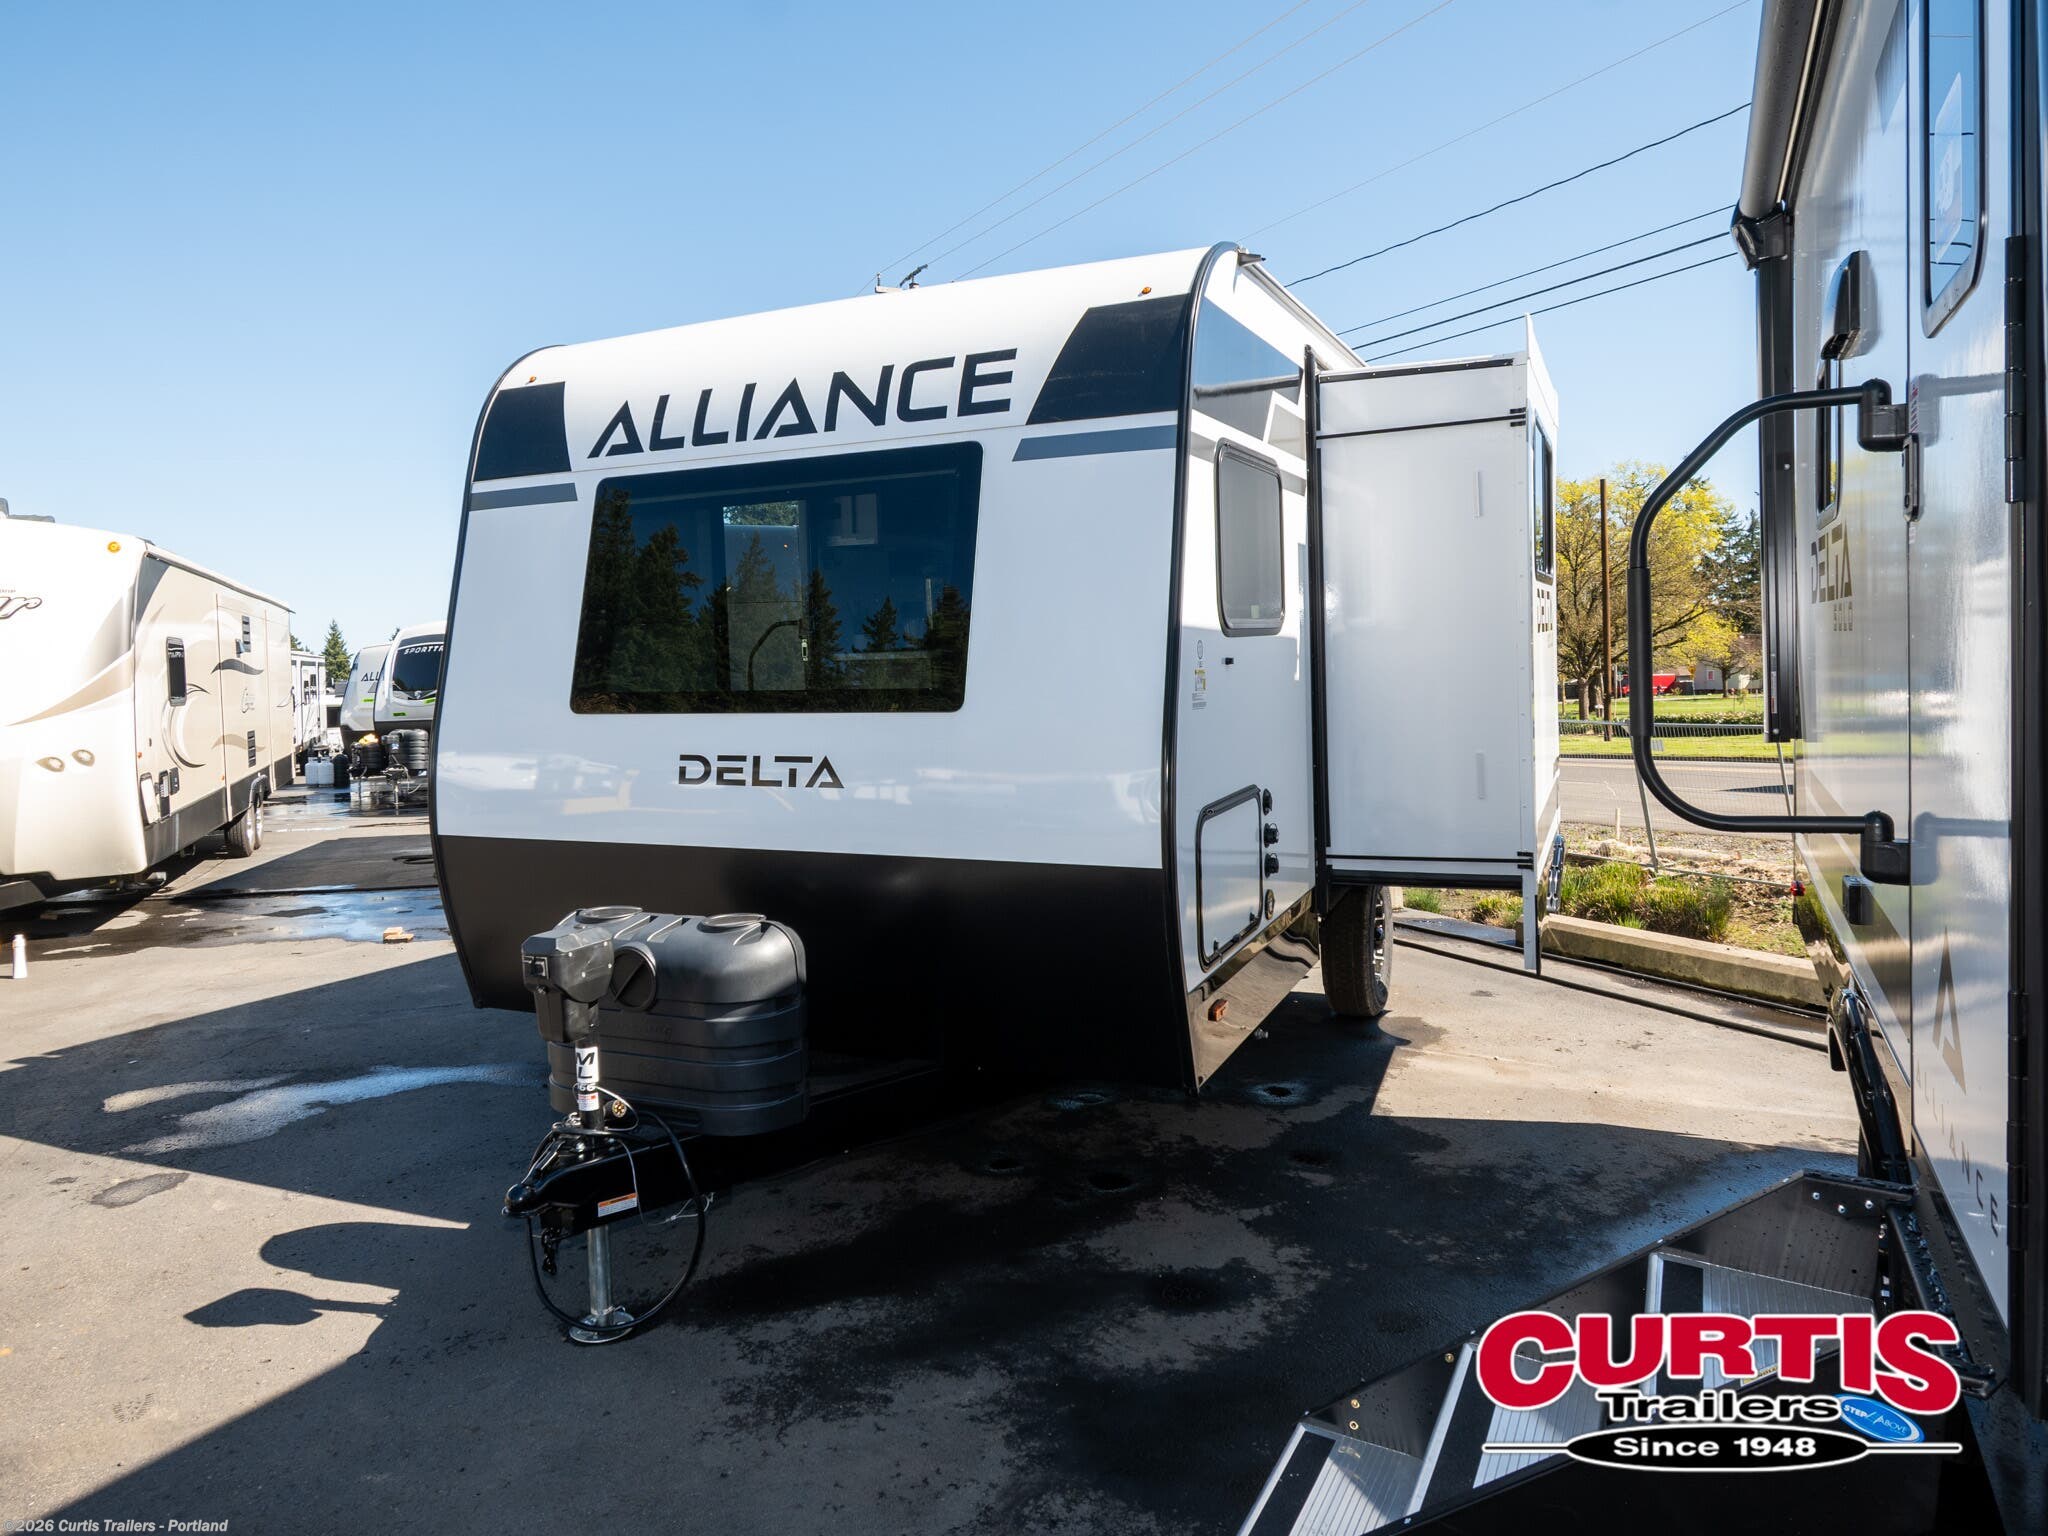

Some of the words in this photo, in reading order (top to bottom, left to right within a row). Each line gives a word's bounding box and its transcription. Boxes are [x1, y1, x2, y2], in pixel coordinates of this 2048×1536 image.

[587, 348, 1018, 459] ALLIANCE
[1811, 520, 1852, 604] DELTA
[678, 754, 845, 788] DELTA
[1916, 1058, 1998, 1237] ALLIANCE
[1843, 1404, 1867, 1418] STEP
